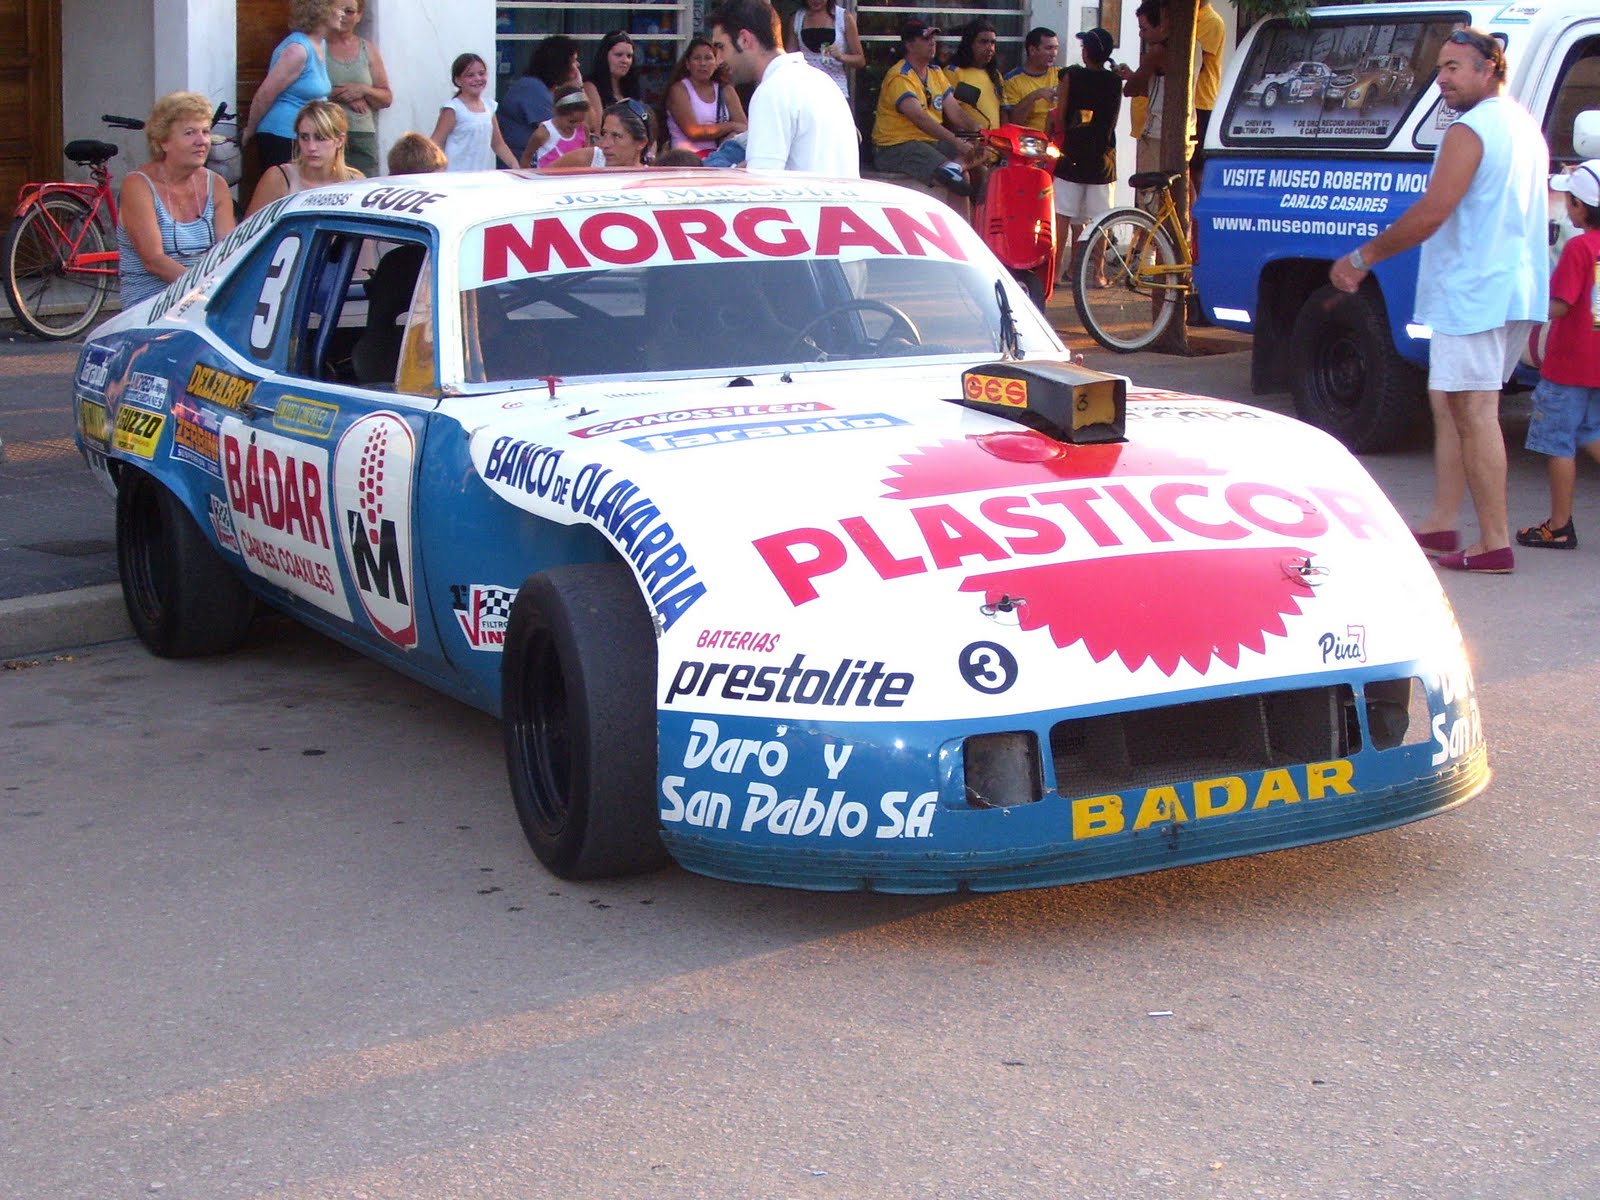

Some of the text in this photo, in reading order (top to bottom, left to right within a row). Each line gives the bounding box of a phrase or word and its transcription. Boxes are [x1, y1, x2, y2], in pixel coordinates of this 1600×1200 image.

[361, 187, 448, 214] GUDE
[1222, 169, 1265, 187] VISITE
[1268, 170, 1320, 189] MUSEO
[1322, 171, 1392, 191] ROBERTO
[1280, 194, 1388, 213] CARLOS CASARES
[482, 206, 969, 282] MORGAN
[250, 236, 301, 349] 3
[965, 376, 1026, 405] GES
[585, 402, 816, 436] CANOSSILEN
[484, 436, 707, 634] BANCO DE OLAVARRIA
[751, 482, 1388, 607] PLASTICOR
[696, 630, 781, 653] BATERIAS
[969, 646, 1007, 690] 3
[1318, 632, 1361, 664] Pina
[664, 654, 915, 707] prestolite
[683, 719, 789, 777] Daró
[1431, 713, 1470, 767] San
[661, 775, 731, 830] San
[741, 782, 868, 837] Pablo
[1072, 760, 1357, 840] BADAR
